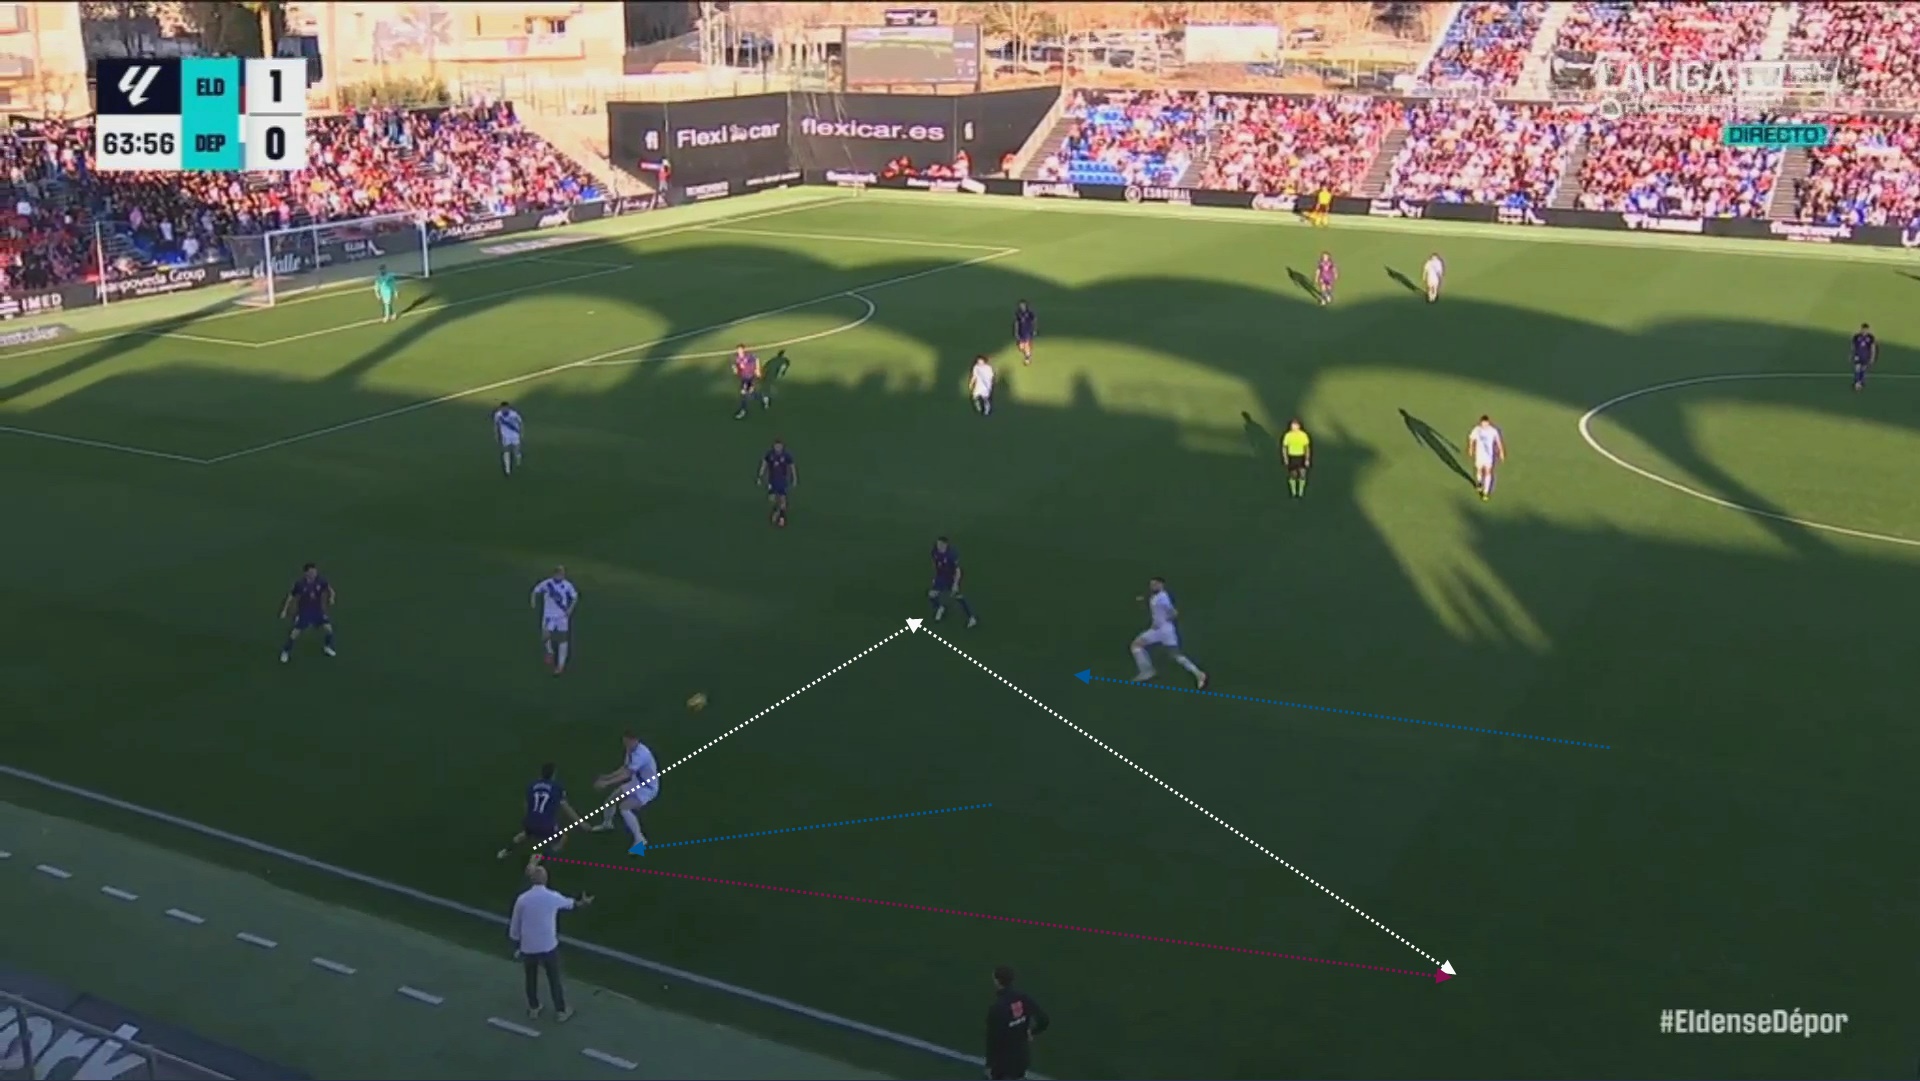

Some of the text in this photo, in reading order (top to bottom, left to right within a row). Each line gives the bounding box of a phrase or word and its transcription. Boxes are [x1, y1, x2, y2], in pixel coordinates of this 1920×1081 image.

[801, 118, 945, 141] flexicar.es
[169, 268, 206, 284] Group
[22, 292, 62, 310] IMED
[533, 791, 551, 813] 17
